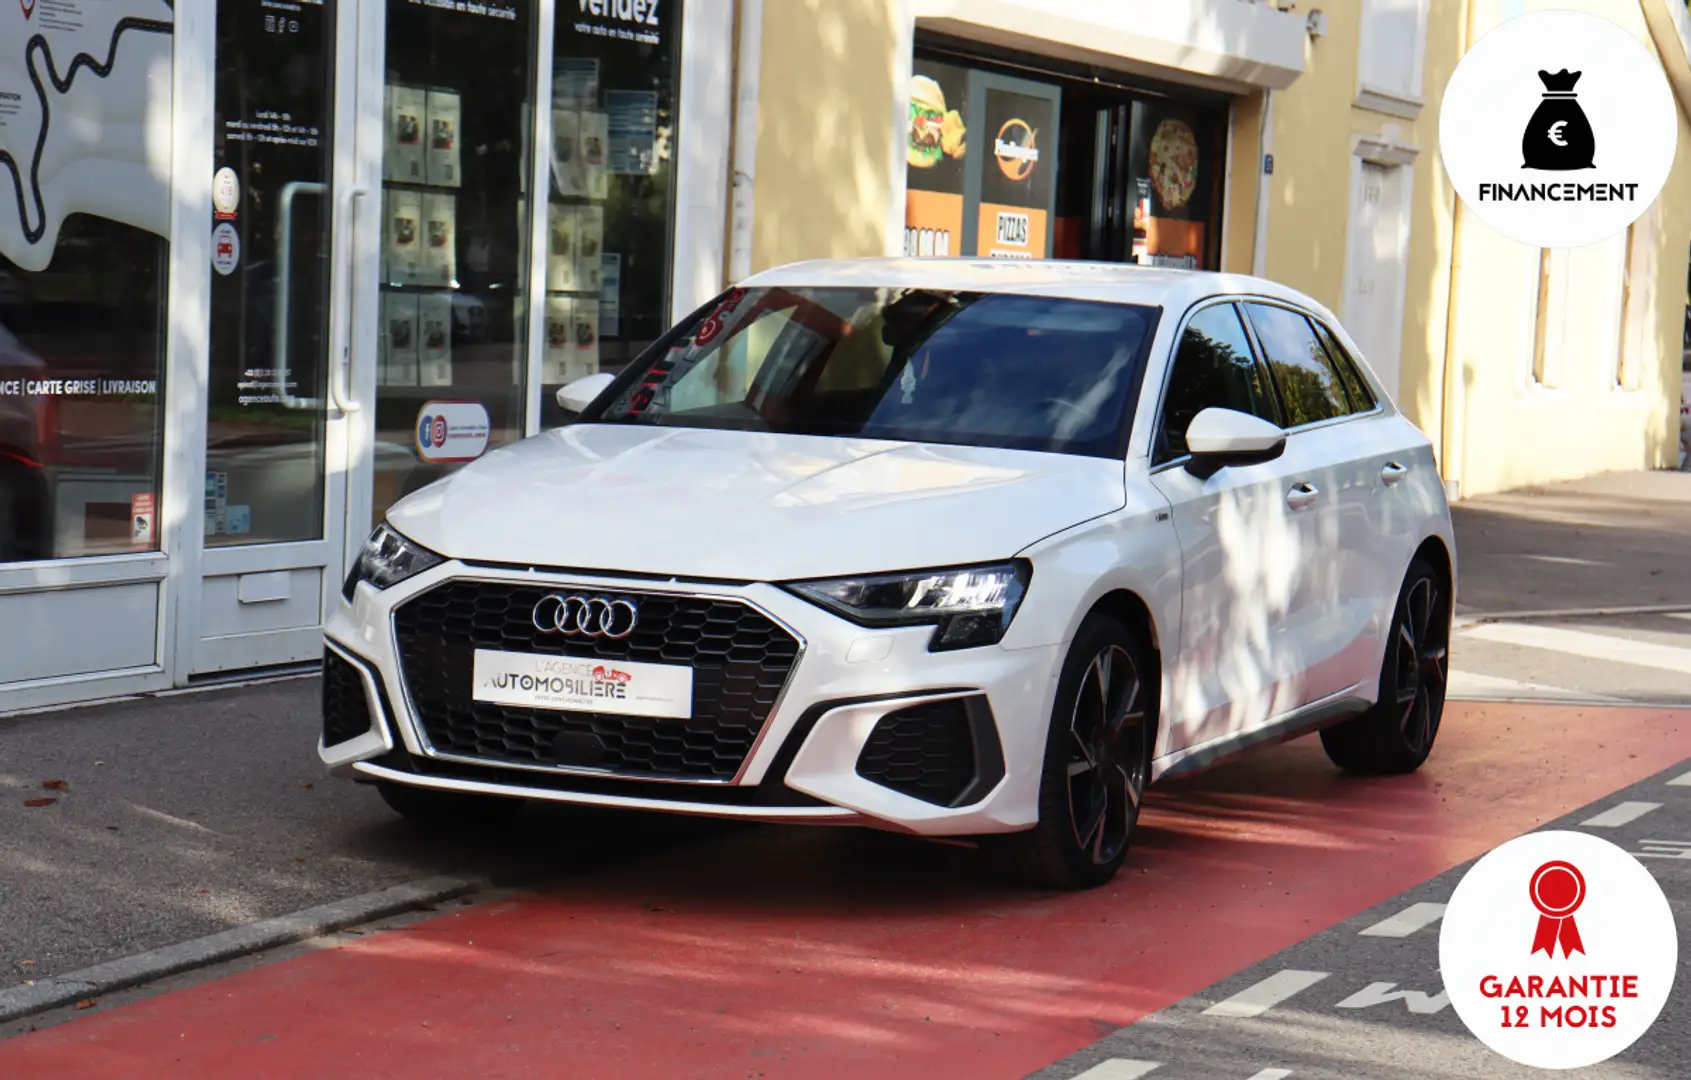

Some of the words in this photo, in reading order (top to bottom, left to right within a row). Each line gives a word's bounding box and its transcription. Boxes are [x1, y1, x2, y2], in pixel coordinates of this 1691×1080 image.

[997, 215, 1027, 243] PIZZAS
[27, 380, 63, 395] CARTE
[64, 380, 97, 395] GRISE
[103, 380, 156, 395] LIVRAISON
